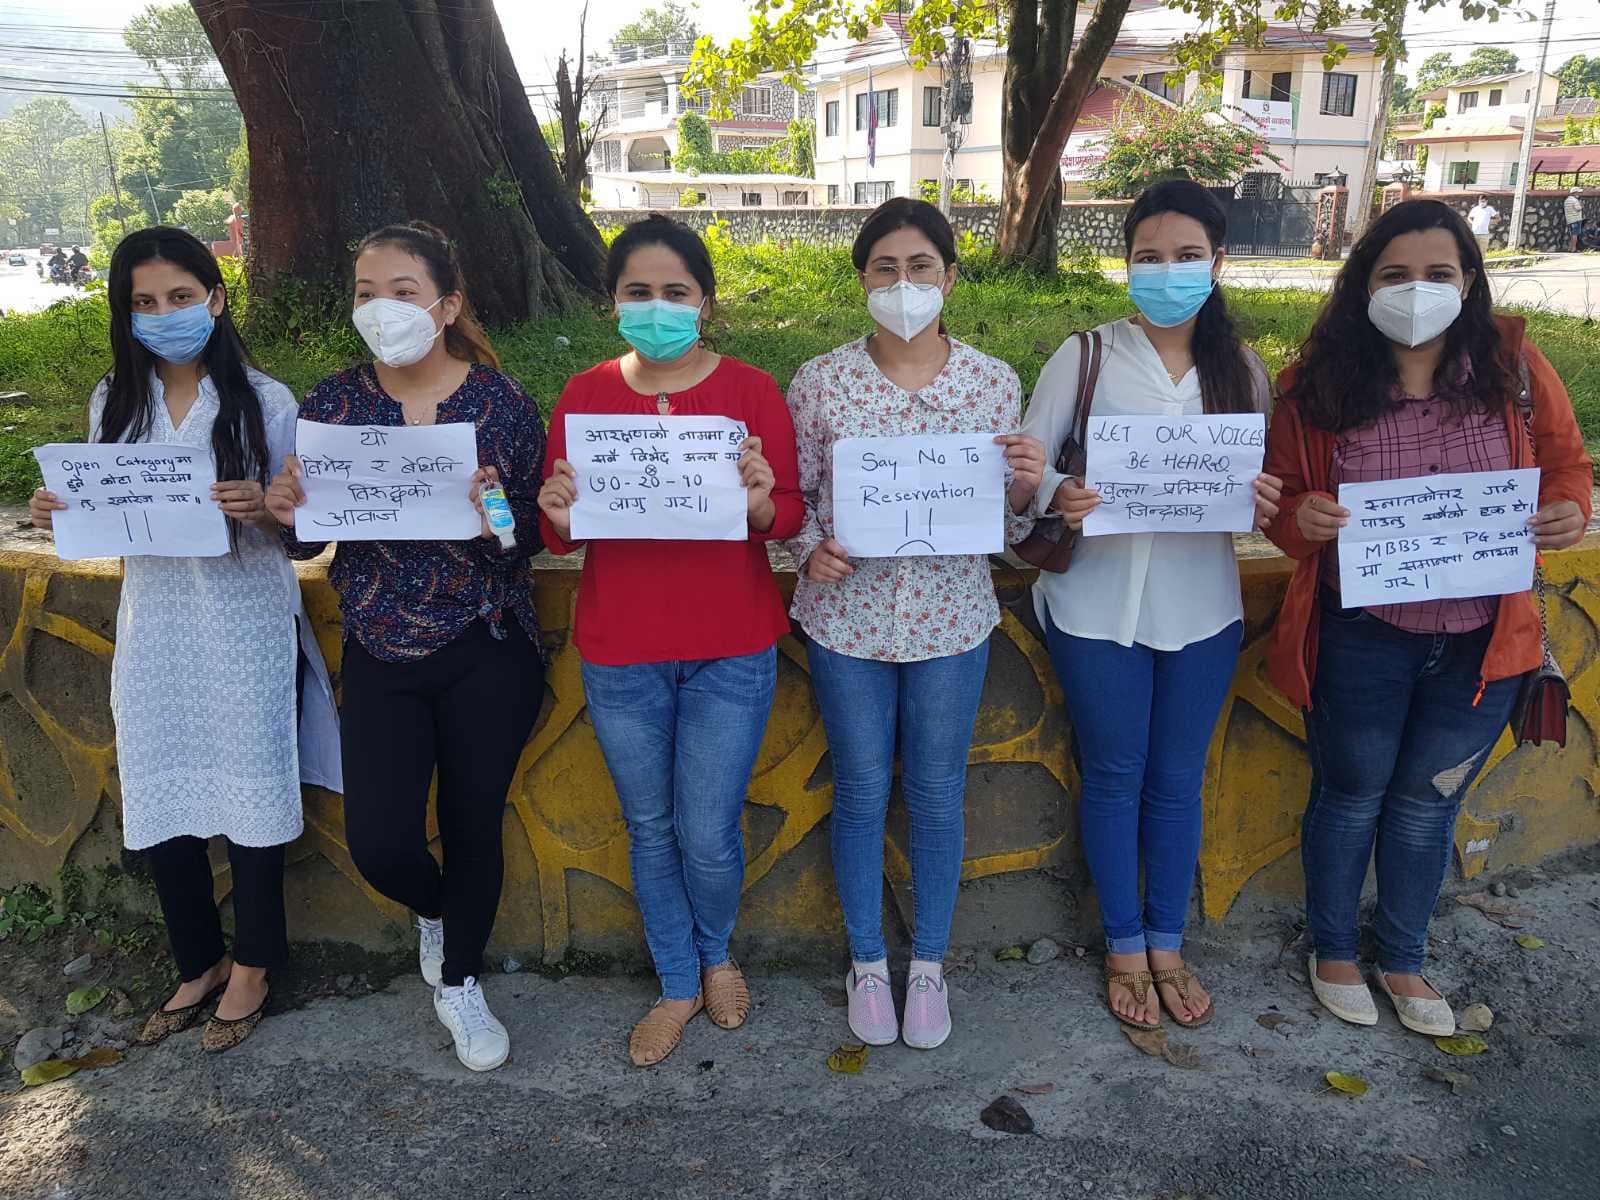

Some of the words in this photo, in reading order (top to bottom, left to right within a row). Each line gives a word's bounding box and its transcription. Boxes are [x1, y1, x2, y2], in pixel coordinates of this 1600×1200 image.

[360, 427, 389, 447] यो
[1093, 420, 1132, 443] LET
[1156, 424, 1197, 444] OUR
[1207, 423, 1264, 447] VOICES
[61, 459, 100, 477] Open
[371, 459, 391, 472] र
[861, 452, 897, 481] Say
[918, 448, 946, 465] No
[959, 447, 980, 464] To
[1125, 451, 1152, 470] BE
[859, 481, 974, 507] Reservation
[609, 496, 649, 514] लागु
[313, 509, 400, 528] आवाज
[1365, 538, 1421, 560] MBBS
[1429, 535, 1448, 547] र
[1462, 530, 1490, 545] PG
[1498, 527, 1529, 541] seat
[1356, 562, 1383, 578] मा
